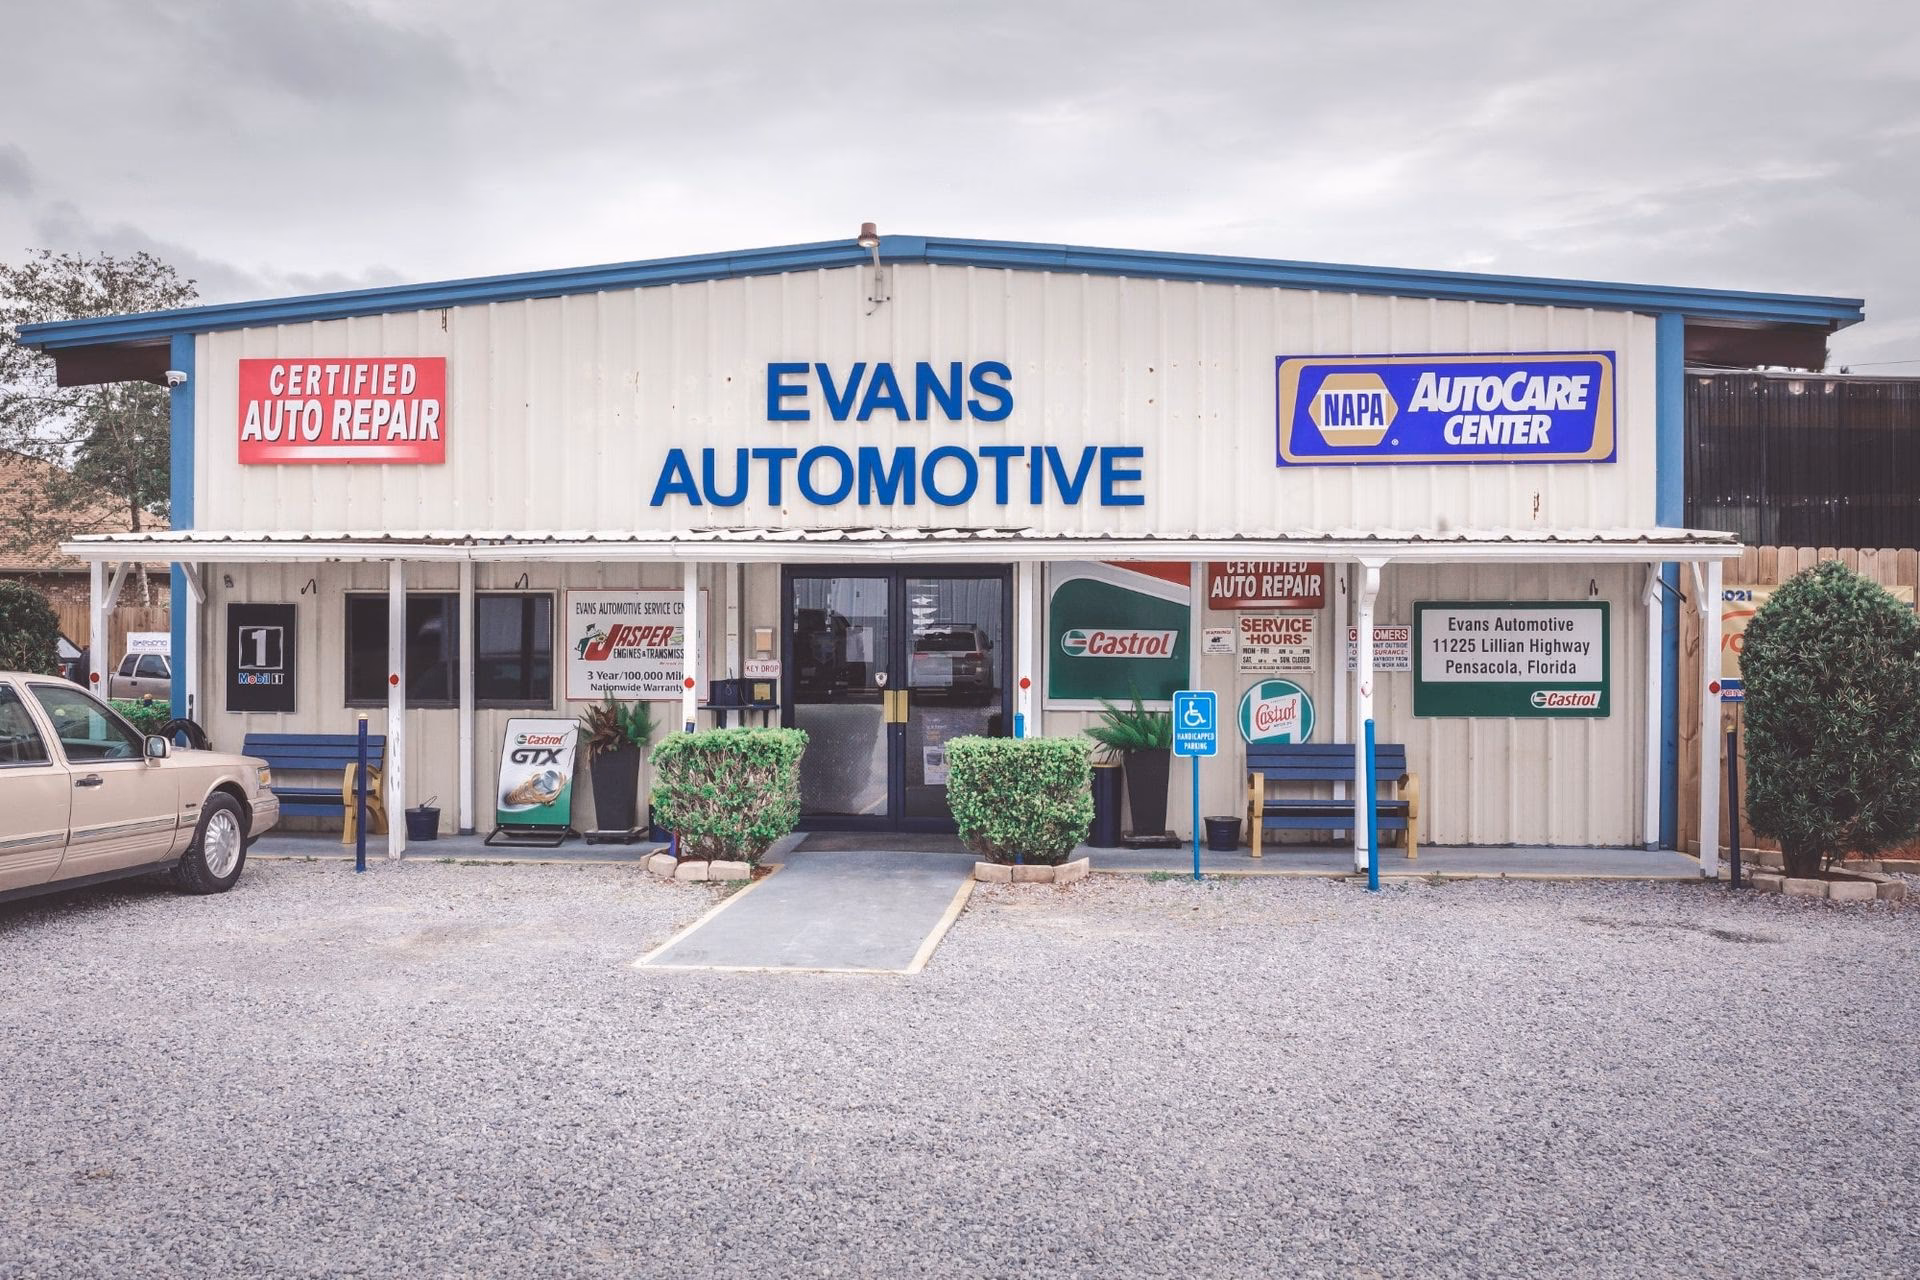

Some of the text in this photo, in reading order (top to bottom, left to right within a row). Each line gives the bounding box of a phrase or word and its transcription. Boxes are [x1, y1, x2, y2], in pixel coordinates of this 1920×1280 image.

[269, 364, 417, 396] CERTIFIED
[767, 361, 1014, 422] EVANS
[1324, 393, 1384, 426] NAPA
[240, 398, 440, 442] AUTO REPAIR
[1443, 414, 1552, 445] CENTER
[649, 445, 1145, 507] AUTOMOTIVE
[1226, 561, 1308, 574] CERTIFIED
[1211, 575, 1321, 598] AUTO REPAIR
[1721, 589, 1752, 601] 021
[576, 602, 597, 615] EVANS
[598, 602, 642, 615] AUTOMOTIVE
[644, 602, 671, 615] SERVICE
[1241, 618, 1312, 632] SERVICE
[1448, 617, 1574, 632] Evans Automotive
[251, 629, 267, 666] 1
[584, 623, 674, 661] JASPER
[1088, 631, 1170, 655] Castrol
[1432, 638, 1590, 656] 11225 Lillian Highway
[613, 648, 641, 659] ENGINES
[647, 648, 684, 659] TRANSMISS
[746, 665, 779, 673] KEY DROP
[1445, 660, 1577, 676] Pensacola, Florida
[238, 672, 270, 685] Mobil
[587, 671, 594, 680] 3
[596, 671, 663, 681] Year/100,000
[590, 683, 641, 692] Nationwide
[1548, 693, 1596, 706] Castrol
[1256, 699, 1297, 731] Castrol
[528, 735, 564, 745] Castrol
[1176, 732, 1215, 741] HANDICAPPED
[1183, 741, 1208, 750] PARKING
[511, 748, 567, 766] GTX
